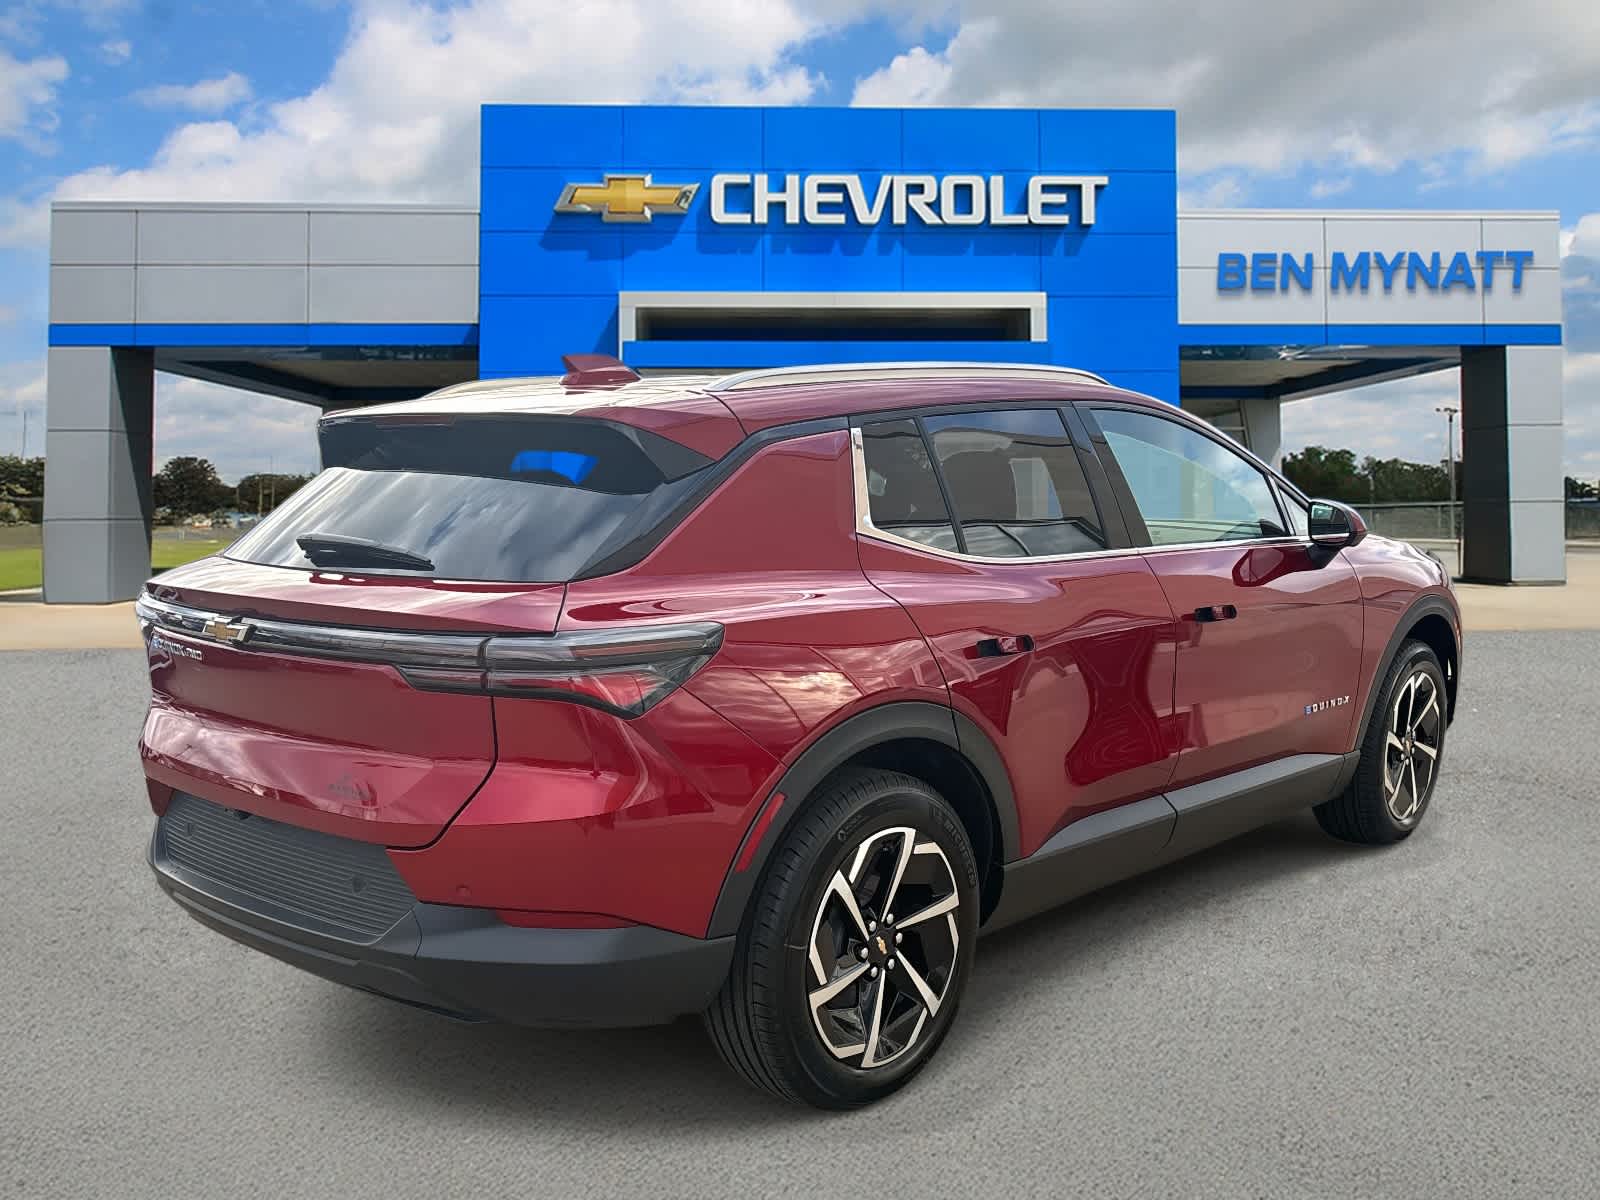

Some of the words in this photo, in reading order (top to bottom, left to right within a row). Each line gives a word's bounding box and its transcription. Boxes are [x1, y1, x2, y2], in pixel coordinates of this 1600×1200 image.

[710, 173, 1109, 225] CHEVROLET
[1217, 252, 1313, 291] BEN
[1330, 250, 1534, 291] MYNATT
[1304, 695, 1350, 715] EQUINOX
